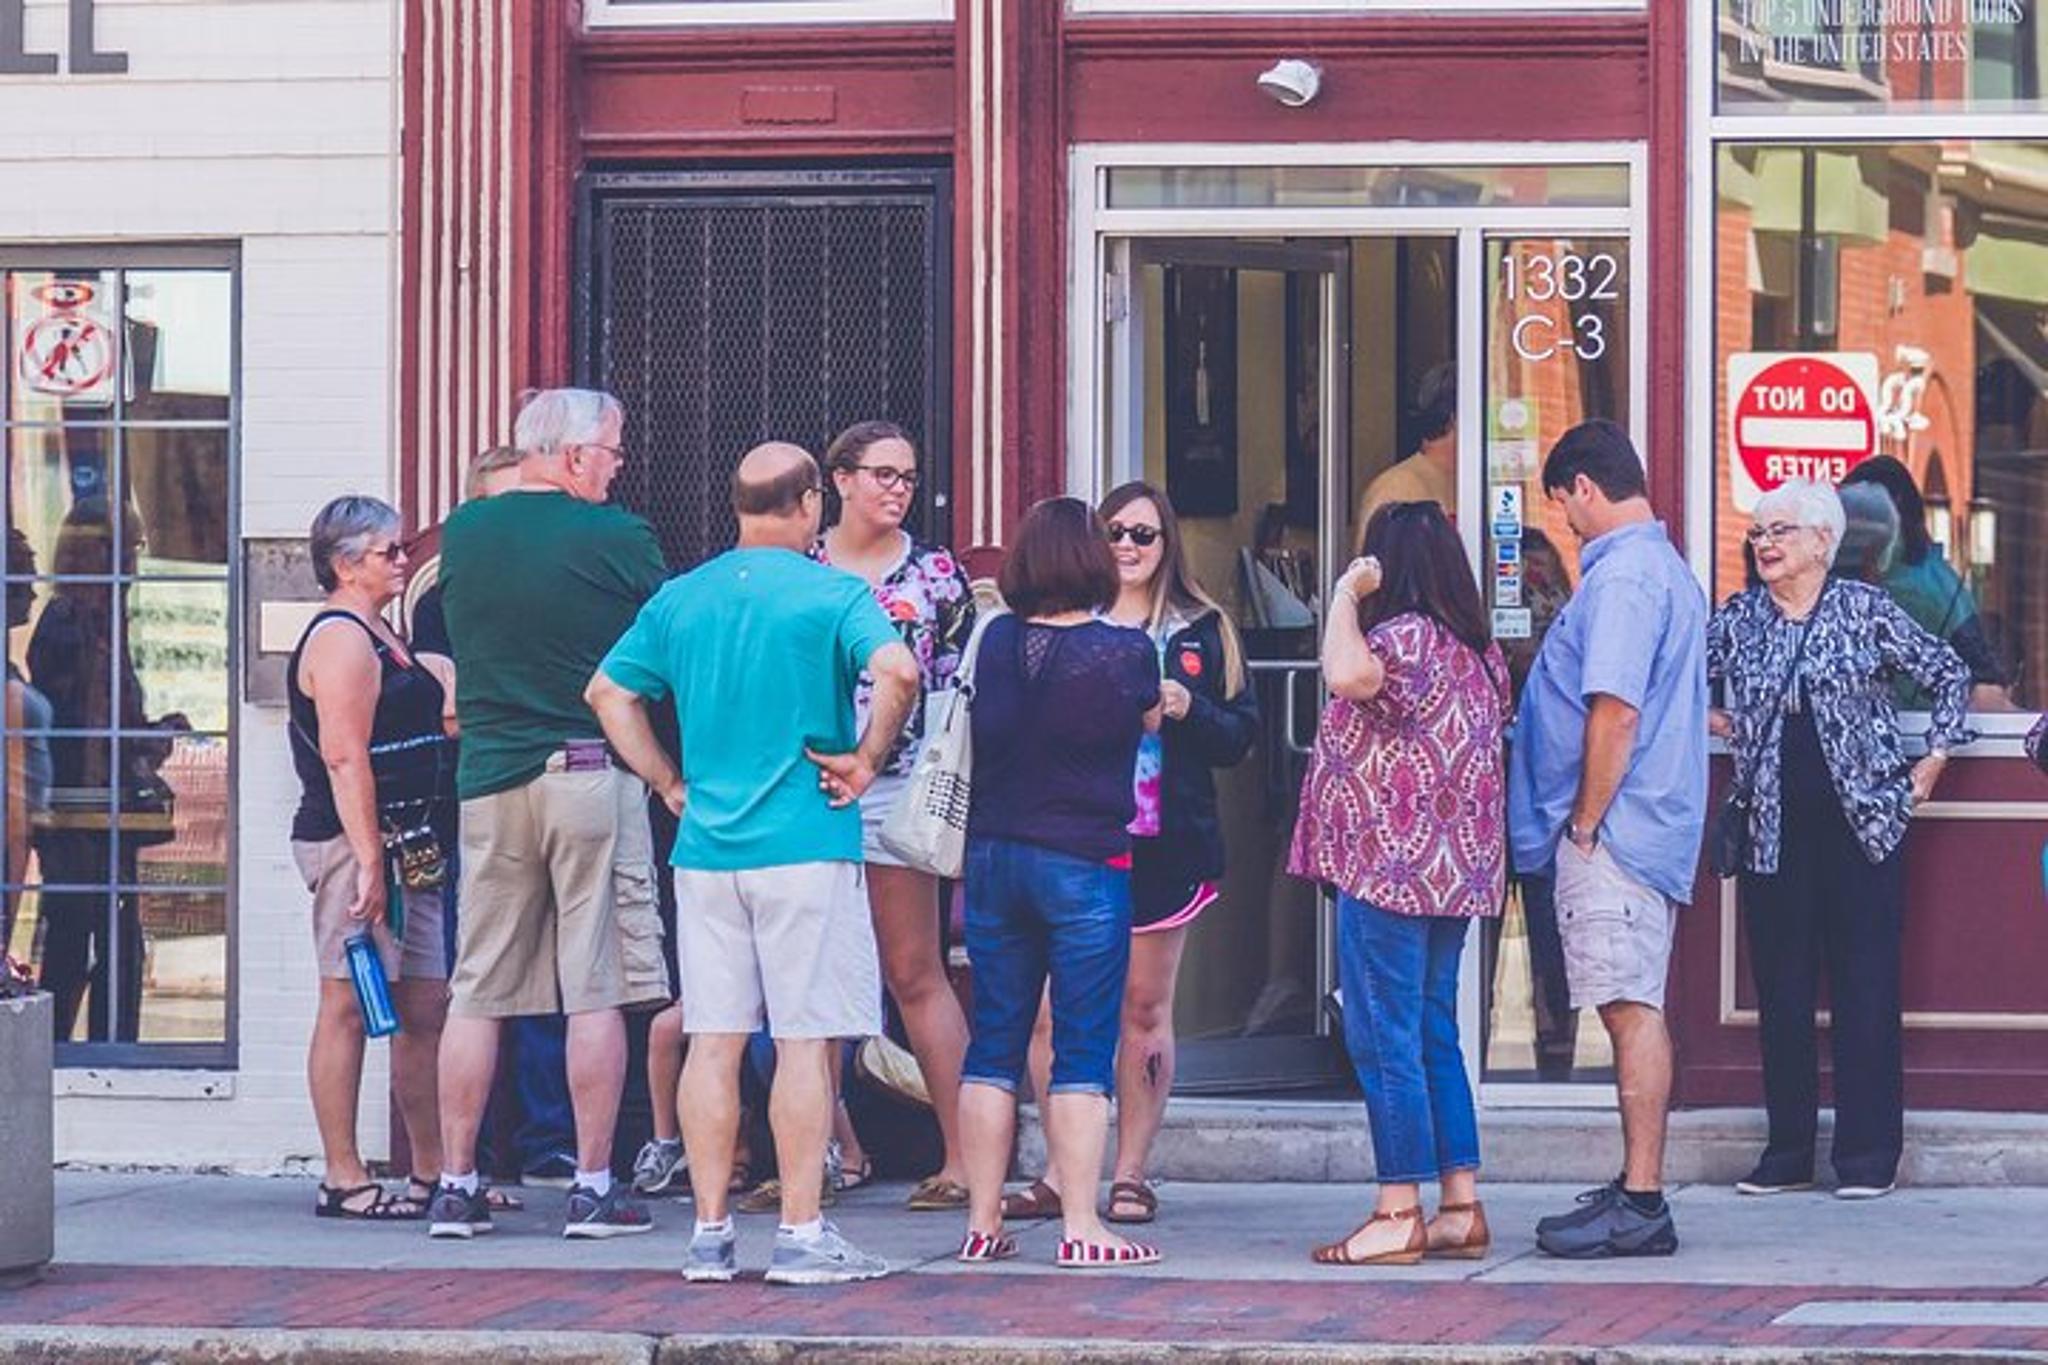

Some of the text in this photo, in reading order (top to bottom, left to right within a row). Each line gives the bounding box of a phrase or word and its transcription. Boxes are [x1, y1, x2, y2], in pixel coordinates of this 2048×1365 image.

[1739, 0, 1778, 27] TOP
[1803, 0, 1953, 26] UNDERGROUND
[1957, 0, 2024, 25] TOURS
[1740, 31, 1968, 63] IN THE UNITED STATES
[1502, 254, 1619, 300] 1332
[1513, 314, 1606, 360] C-3
